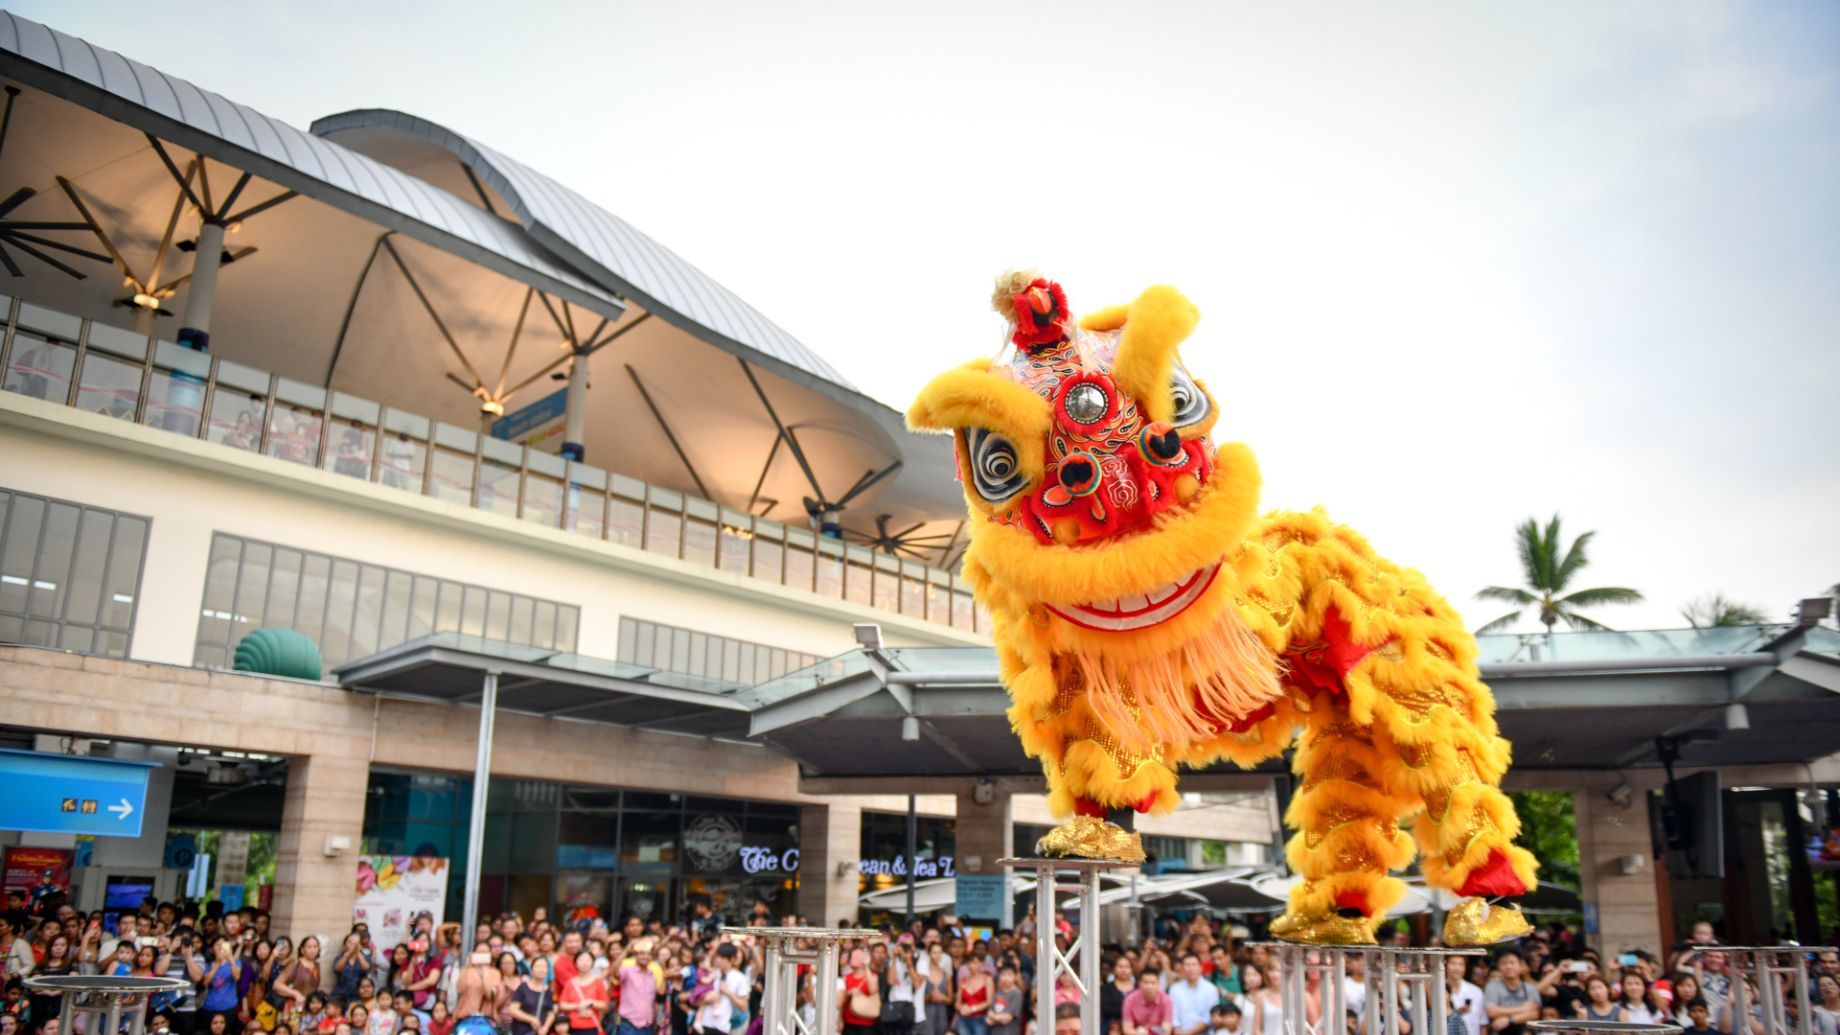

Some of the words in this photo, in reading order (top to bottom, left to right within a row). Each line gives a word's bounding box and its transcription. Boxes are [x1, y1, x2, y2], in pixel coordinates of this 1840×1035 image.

[739, 846, 778, 874] The
[782, 848, 799, 871] C
[857, 859, 892, 877] ean
[892, 854, 907, 875] &
[912, 856, 937, 876] Tea
[938, 856, 956, 877] L
